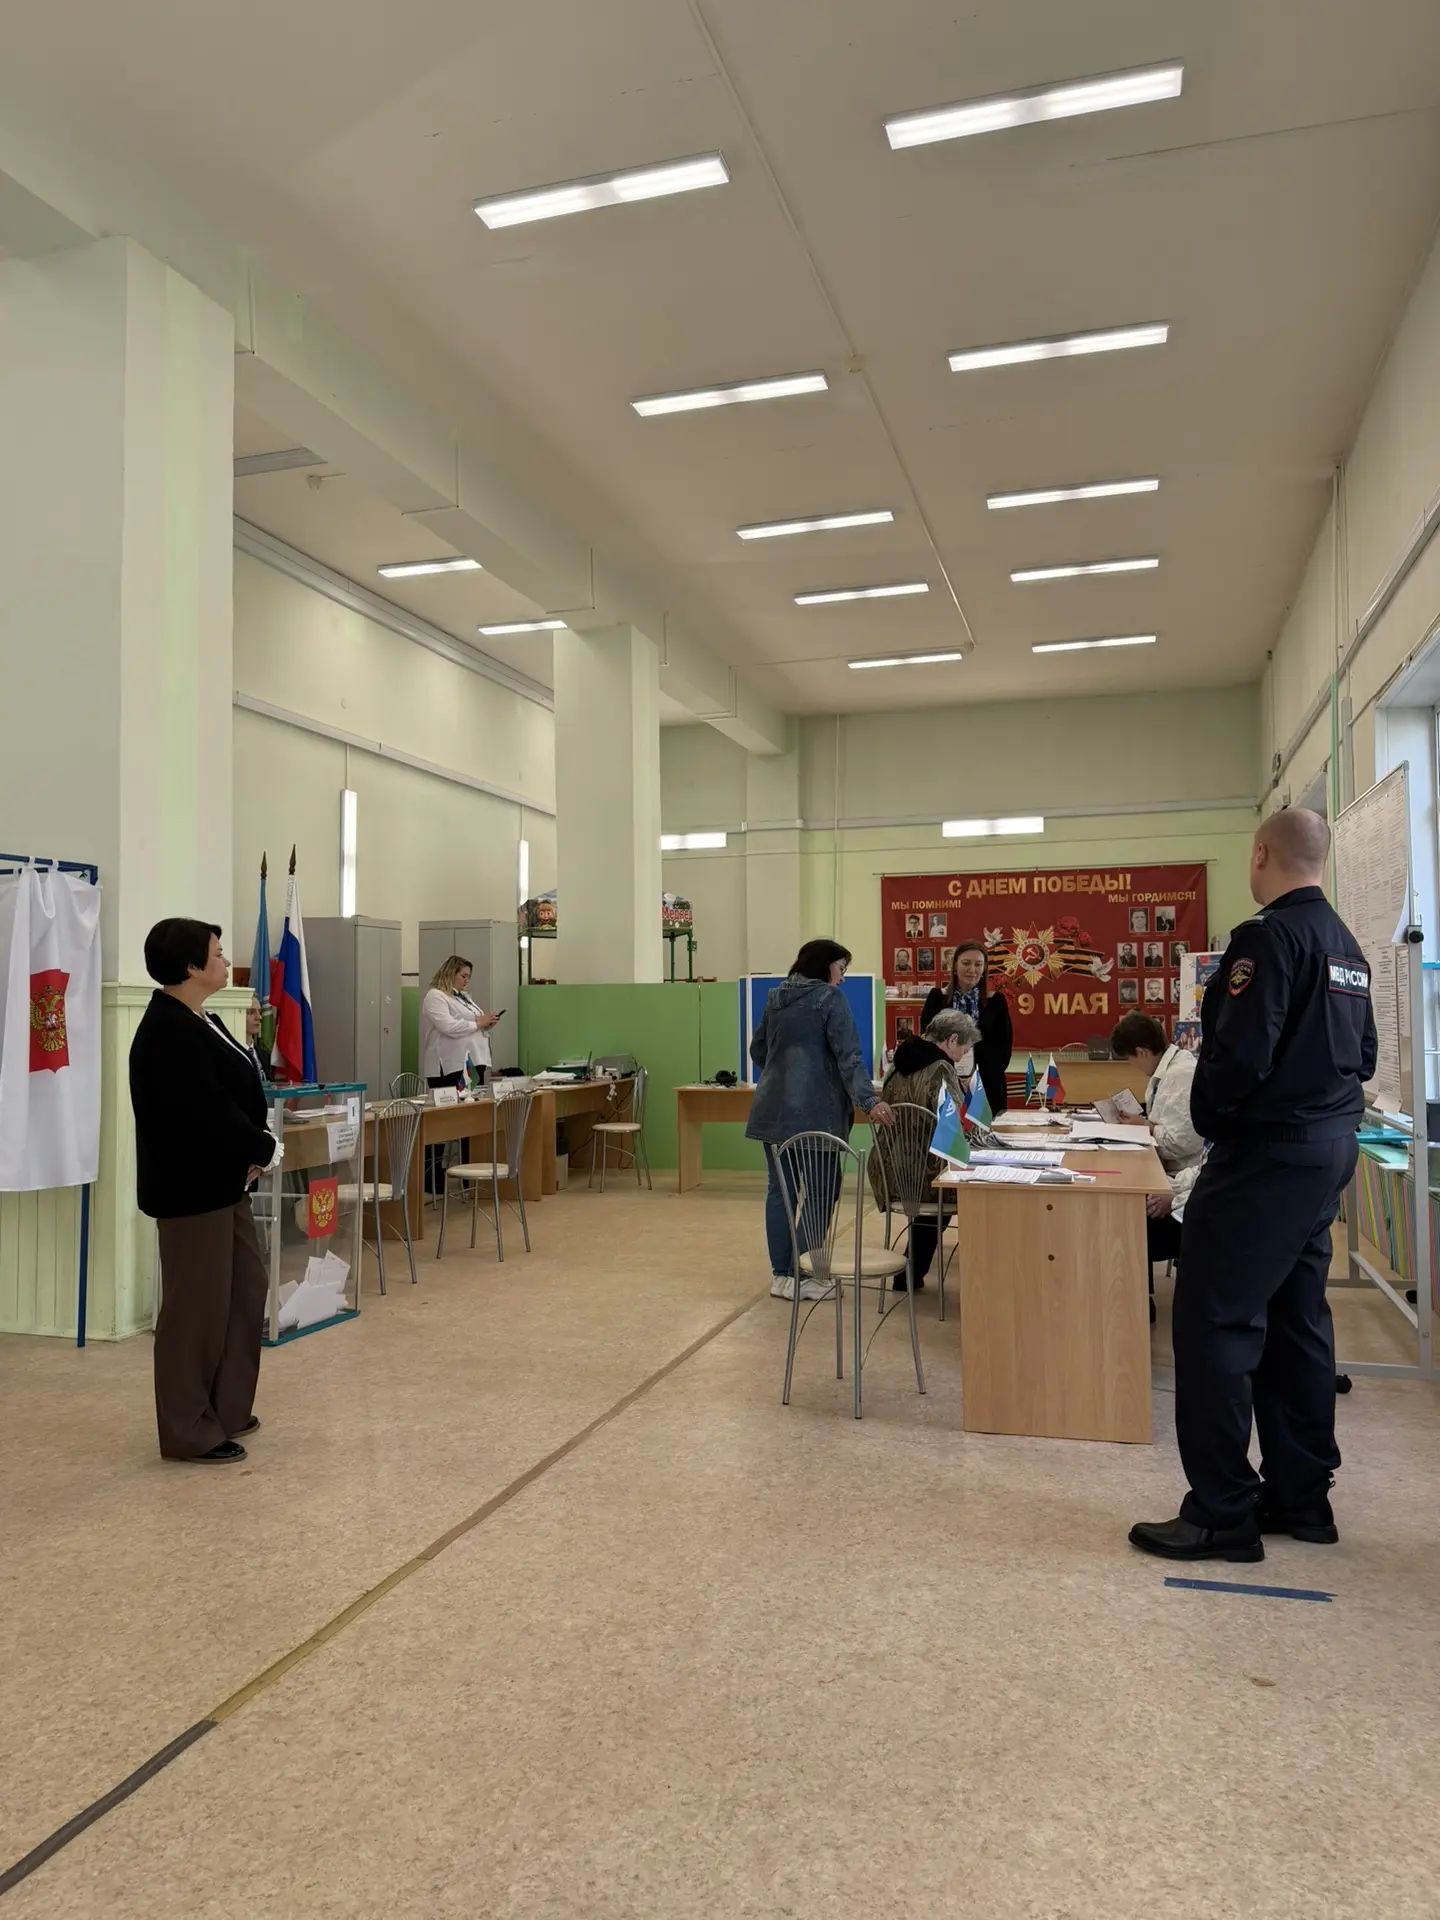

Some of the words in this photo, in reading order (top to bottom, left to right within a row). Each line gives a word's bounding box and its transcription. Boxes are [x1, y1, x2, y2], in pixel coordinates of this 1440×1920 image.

[948, 880, 962, 897] С
[966, 878, 1027, 899] ДНЕМ
[1033, 873, 1132, 895] ПОБЕДЫ!
[1108, 893, 1129, 903] МЫ
[1132, 891, 1196, 904] ГОРДИМСЯ!
[891, 901, 910, 911] МЫ
[912, 899, 962, 910] ПОМНИМ!
[1329, 965, 1346, 987] МВД
[1344, 968, 1368, 988] РССИИ
[1018, 993, 1035, 1015] 9
[1043, 992, 1109, 1015] МАЯ
